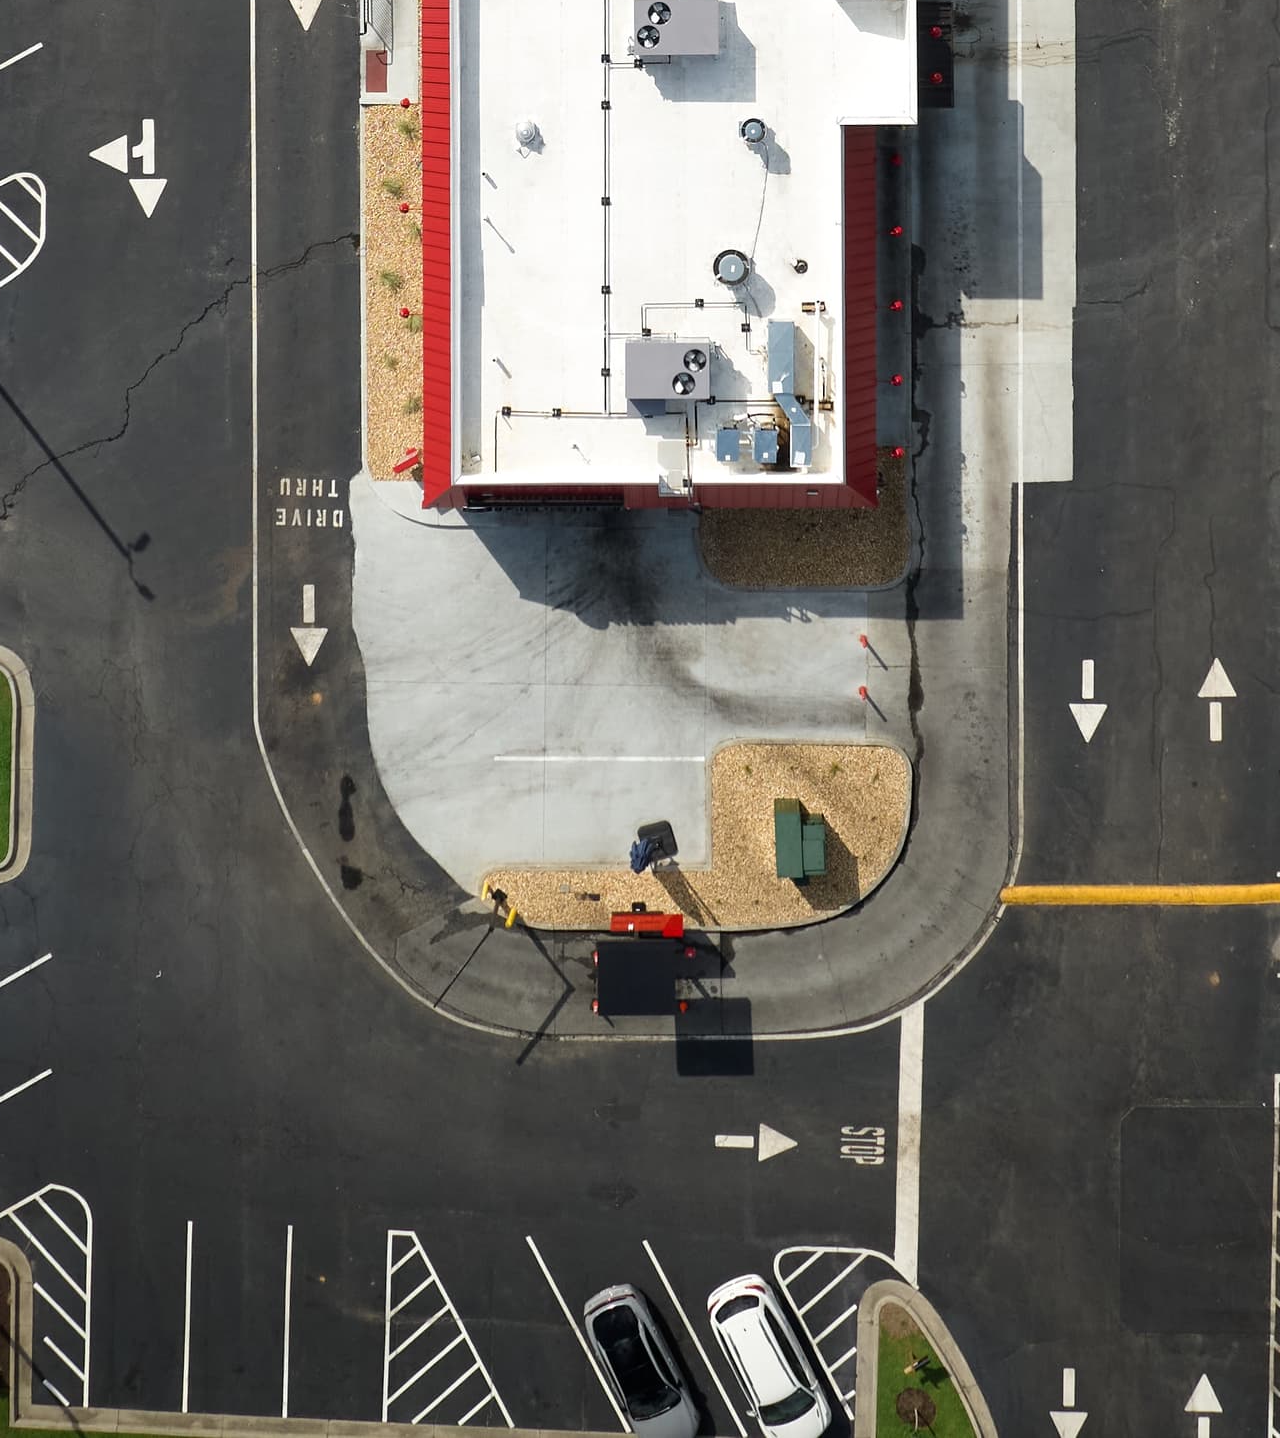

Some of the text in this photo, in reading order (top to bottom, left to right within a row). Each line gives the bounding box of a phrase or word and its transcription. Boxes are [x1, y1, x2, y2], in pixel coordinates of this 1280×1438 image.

[280, 479, 339, 498] THRU
[276, 508, 344, 528] DRIVE
[839, 1124, 886, 1166] STOP
